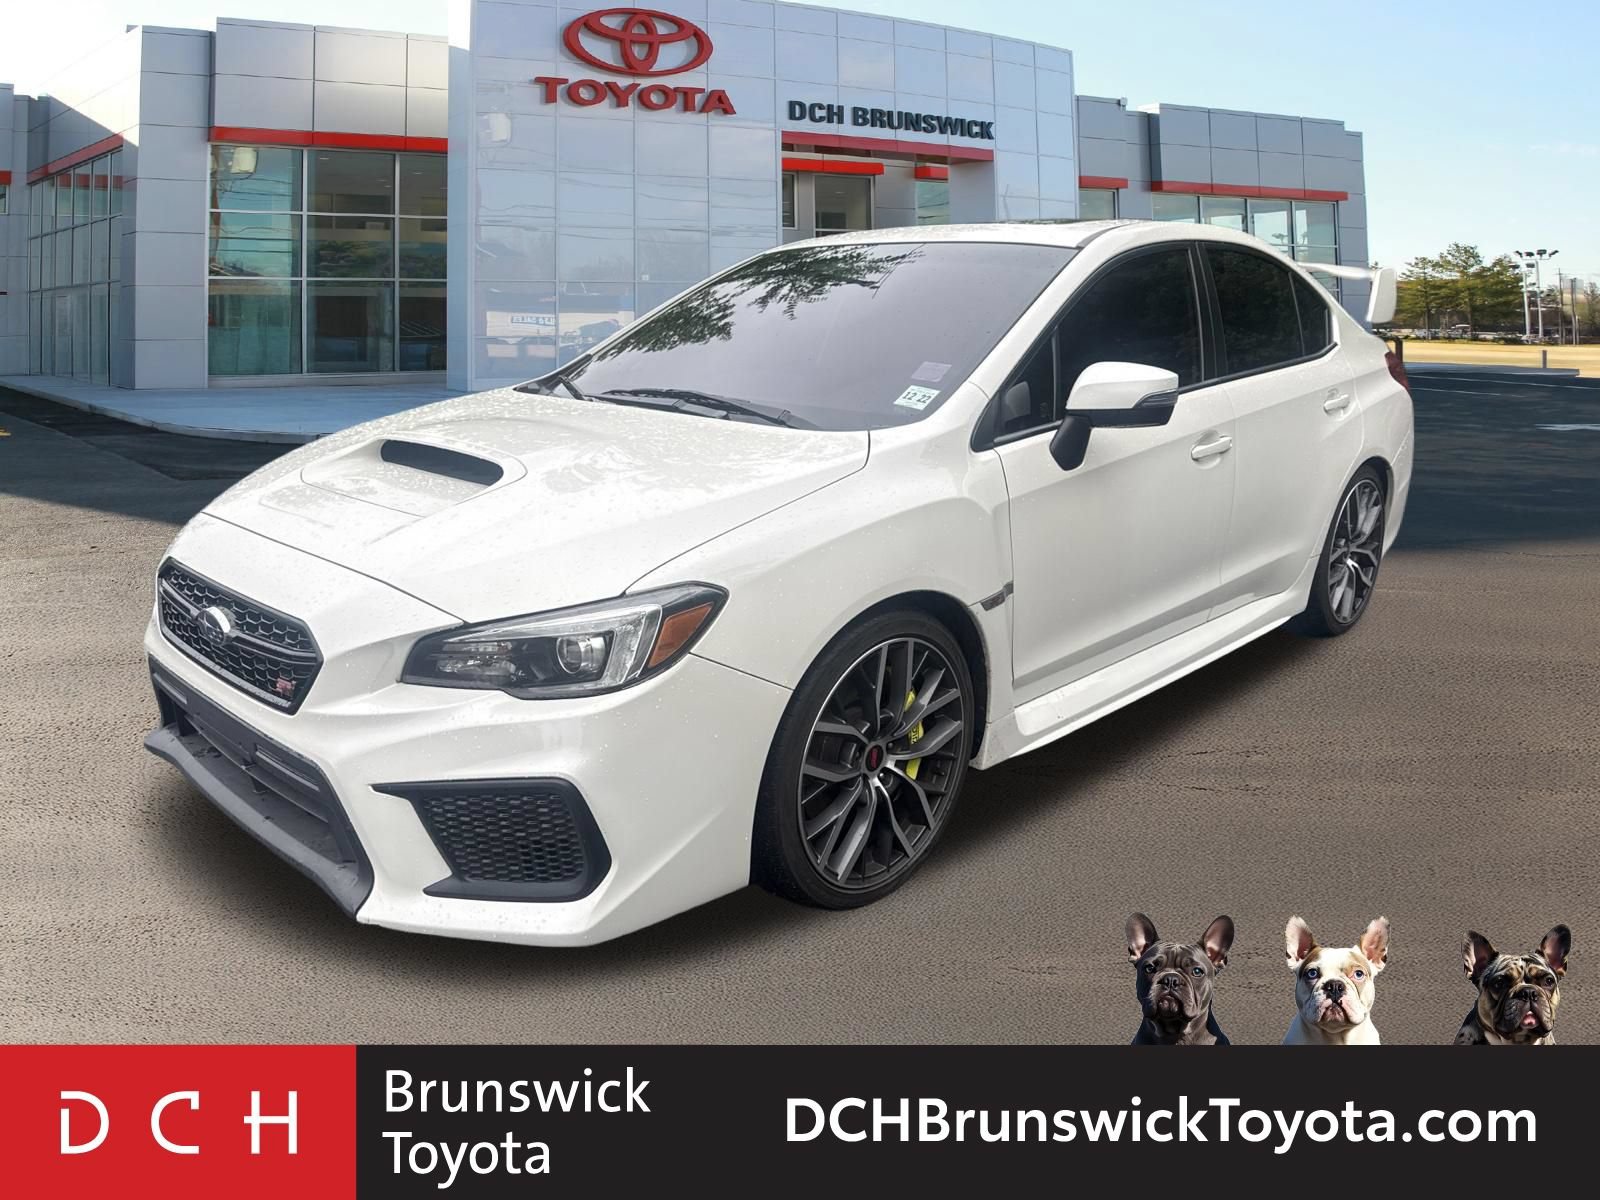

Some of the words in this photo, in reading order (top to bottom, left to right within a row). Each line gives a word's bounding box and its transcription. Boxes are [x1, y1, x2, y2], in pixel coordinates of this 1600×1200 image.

[535, 77, 736, 115] TOYOTA
[788, 100, 845, 125] DCH
[852, 106, 995, 140] BRUNSWICK
